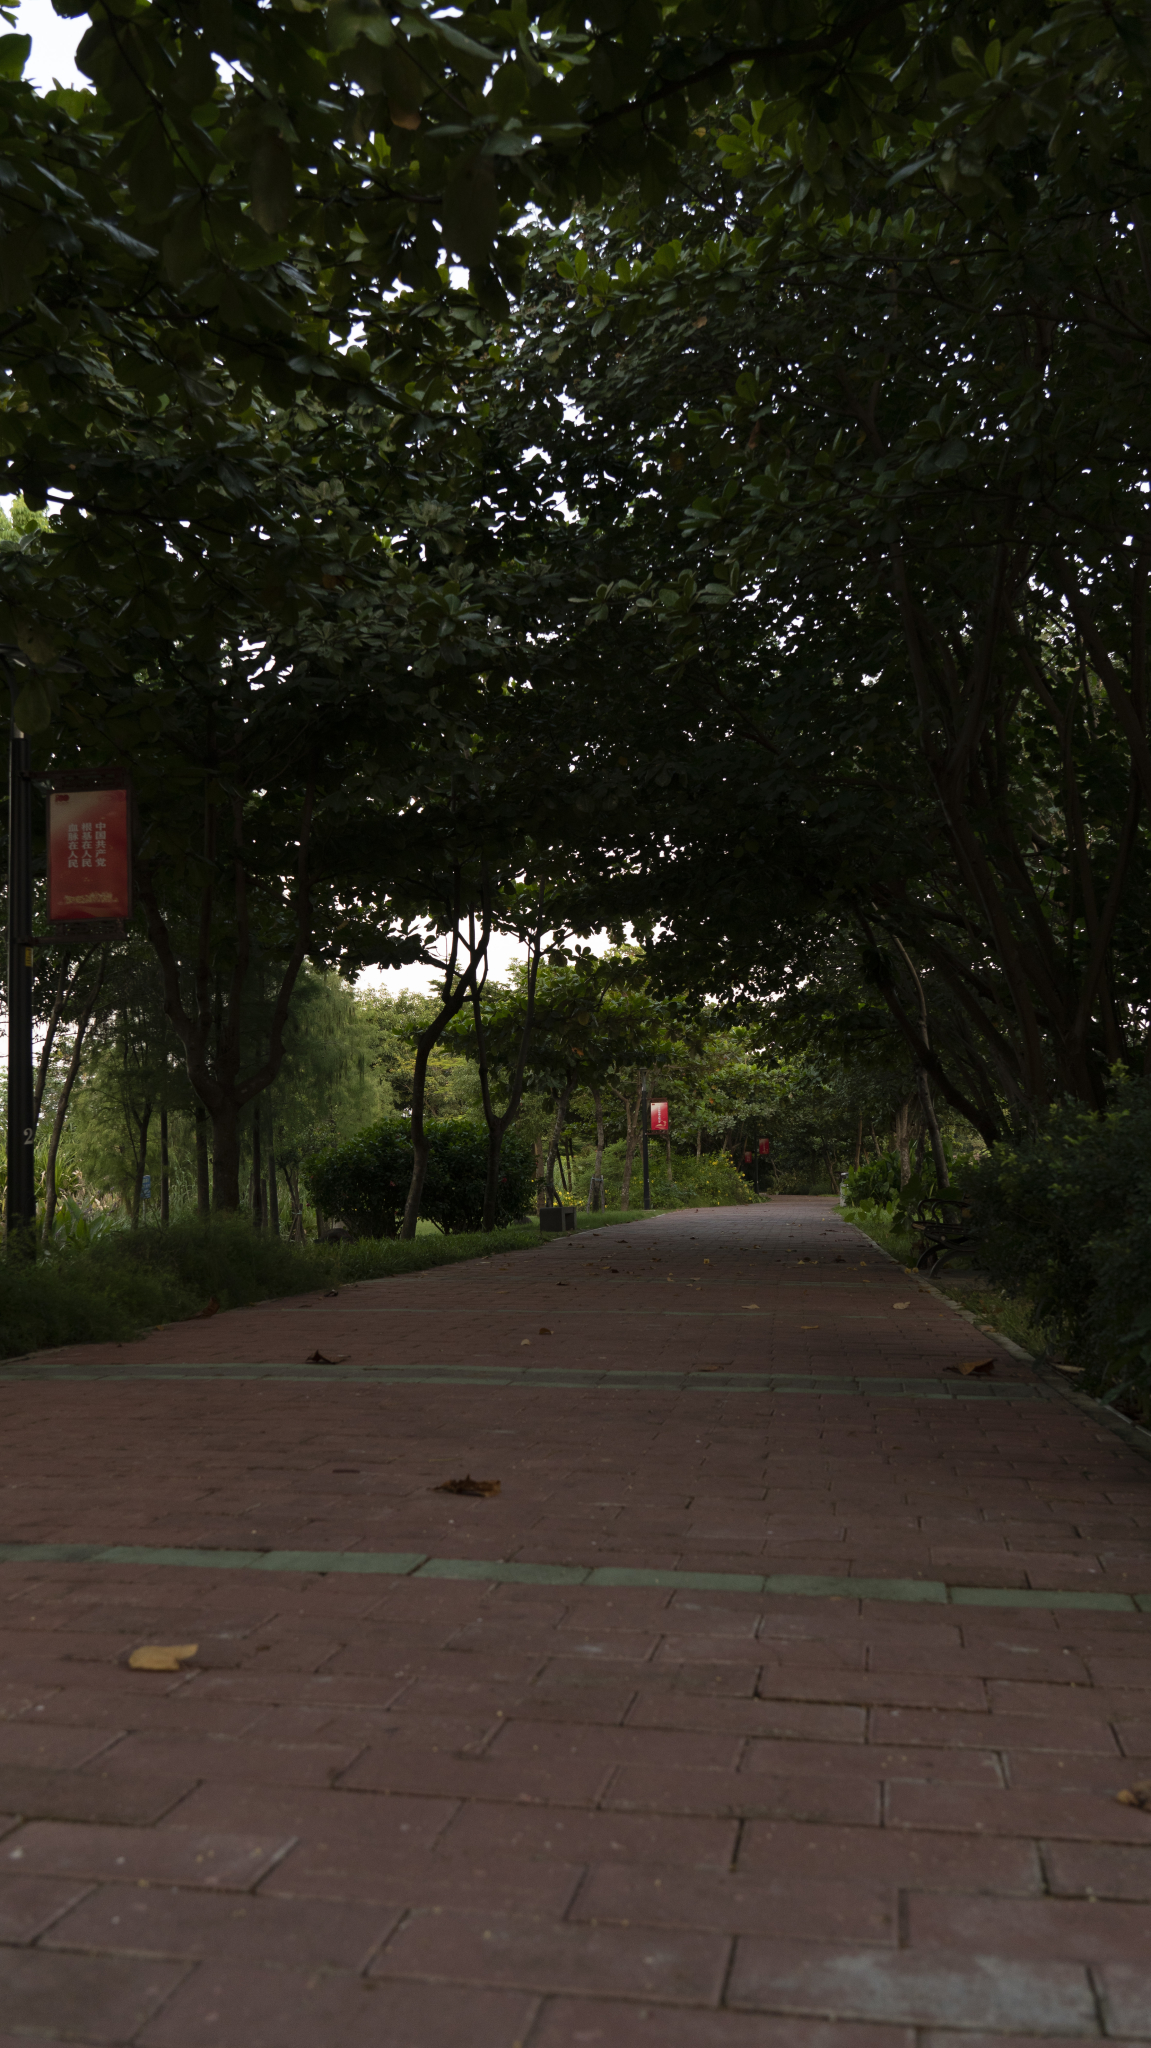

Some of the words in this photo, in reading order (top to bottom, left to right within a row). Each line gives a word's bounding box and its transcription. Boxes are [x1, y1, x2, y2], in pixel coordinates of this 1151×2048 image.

[68, 823, 79, 868] 血脉在人民
[81, 822, 93, 868] 根基在人民
[95, 822, 107, 867] 中国共产党
[23, 1127, 34, 1145] 2
